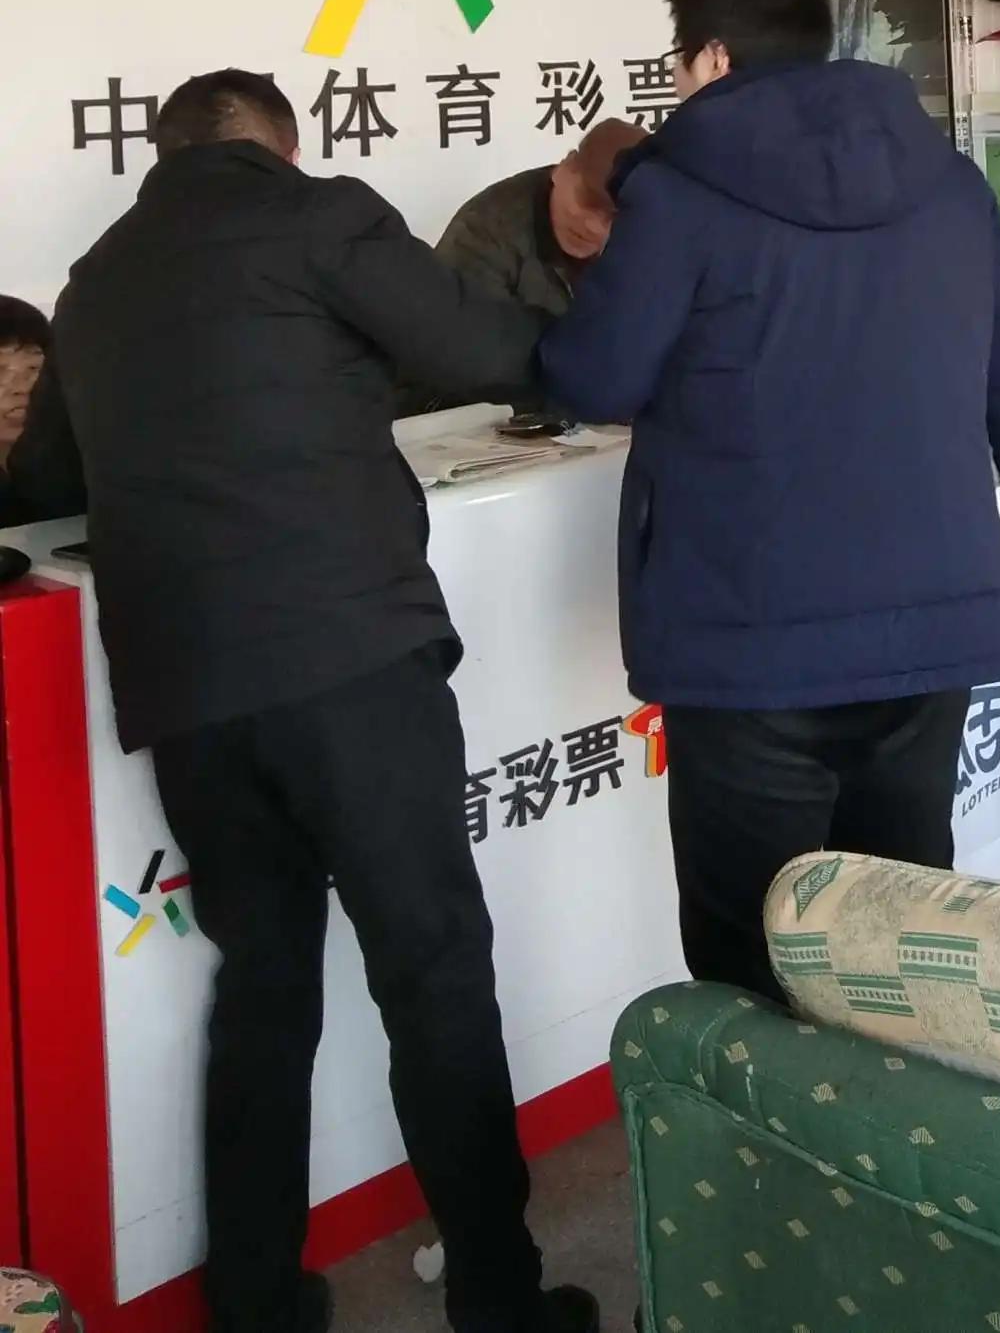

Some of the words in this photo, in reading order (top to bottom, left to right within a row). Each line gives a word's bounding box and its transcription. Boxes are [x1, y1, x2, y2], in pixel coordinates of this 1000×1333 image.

[71, 57, 681, 175] 中体育彩票
